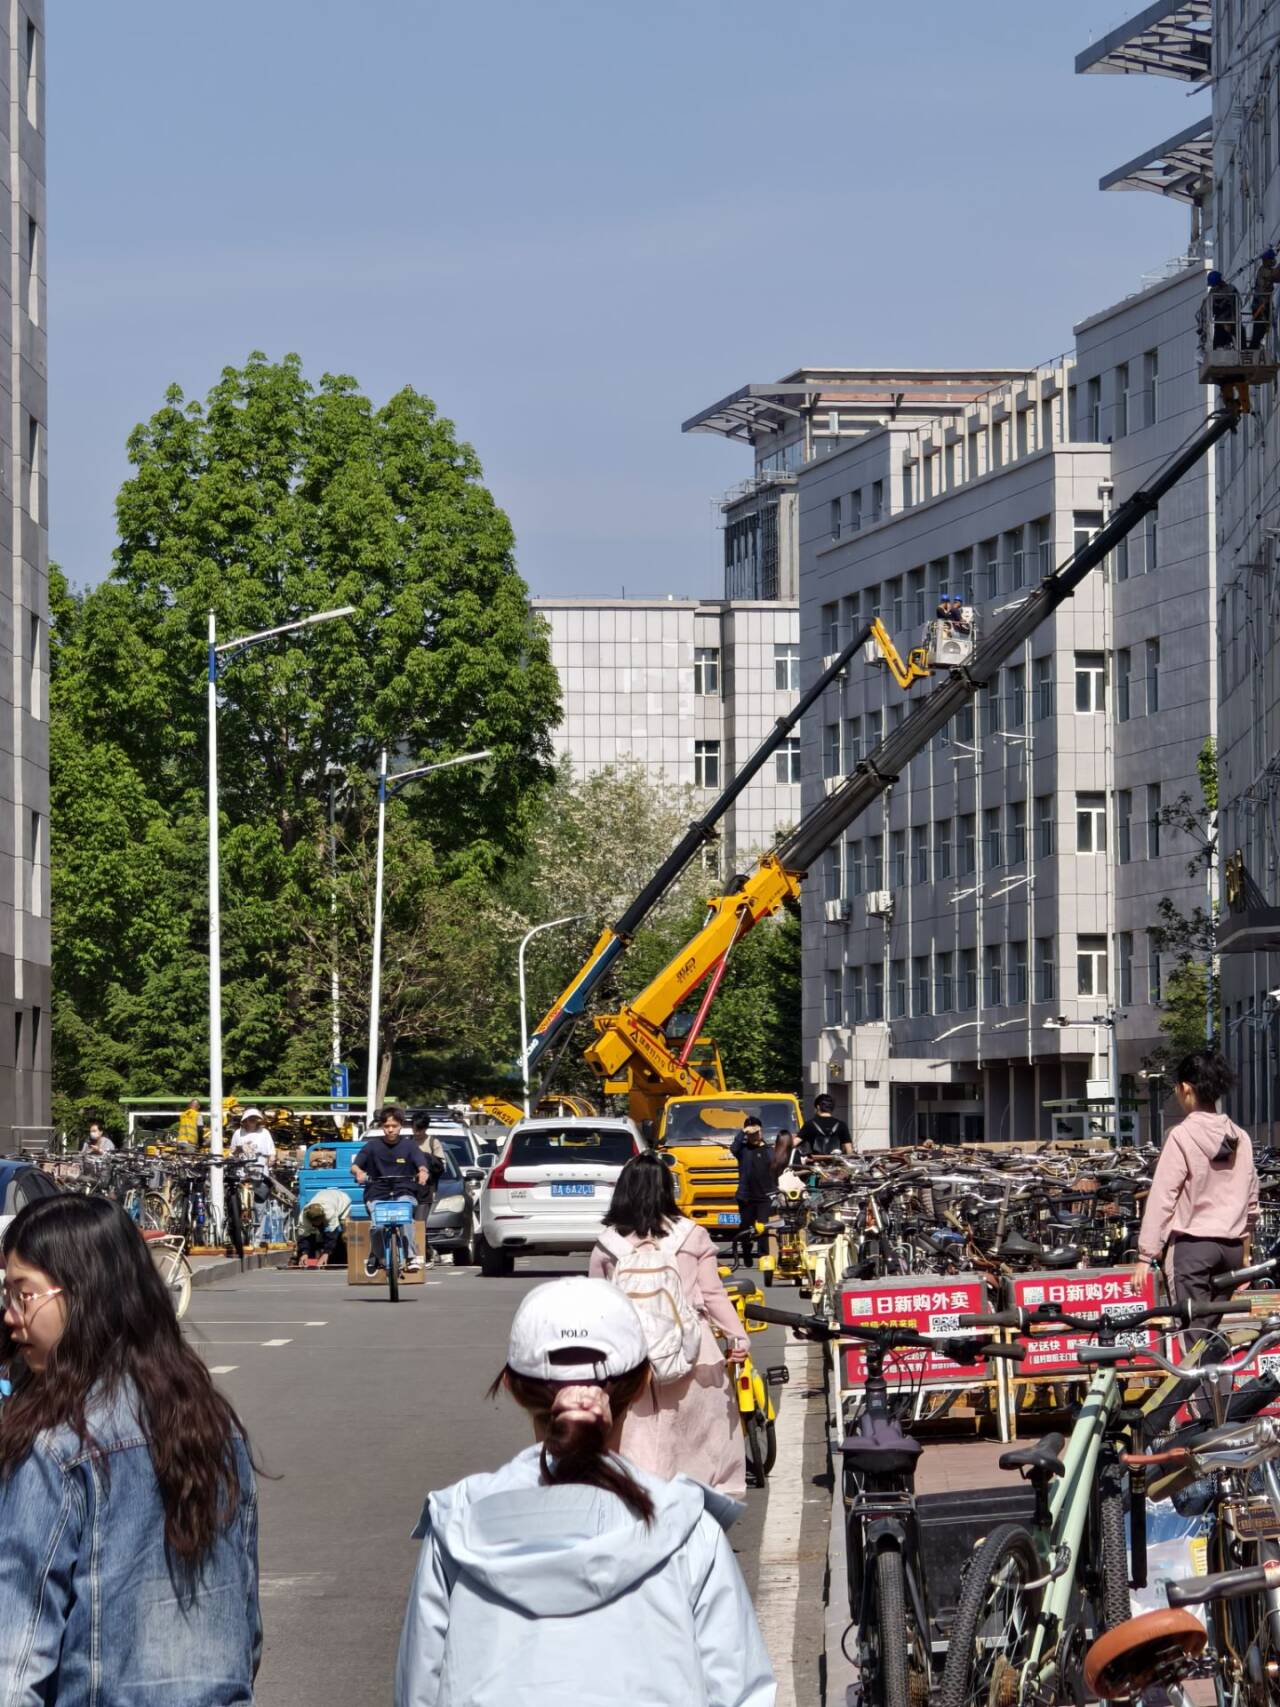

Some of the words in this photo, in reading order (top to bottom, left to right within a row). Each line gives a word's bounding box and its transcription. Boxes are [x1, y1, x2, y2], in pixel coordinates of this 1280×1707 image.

[1049, 1281, 1142, 1303] 日新购外卖
[877, 1291, 970, 1314] 日新购外卖
[561, 1328, 588, 1339] POLO
[1027, 1340, 1061, 1352] 配送快
